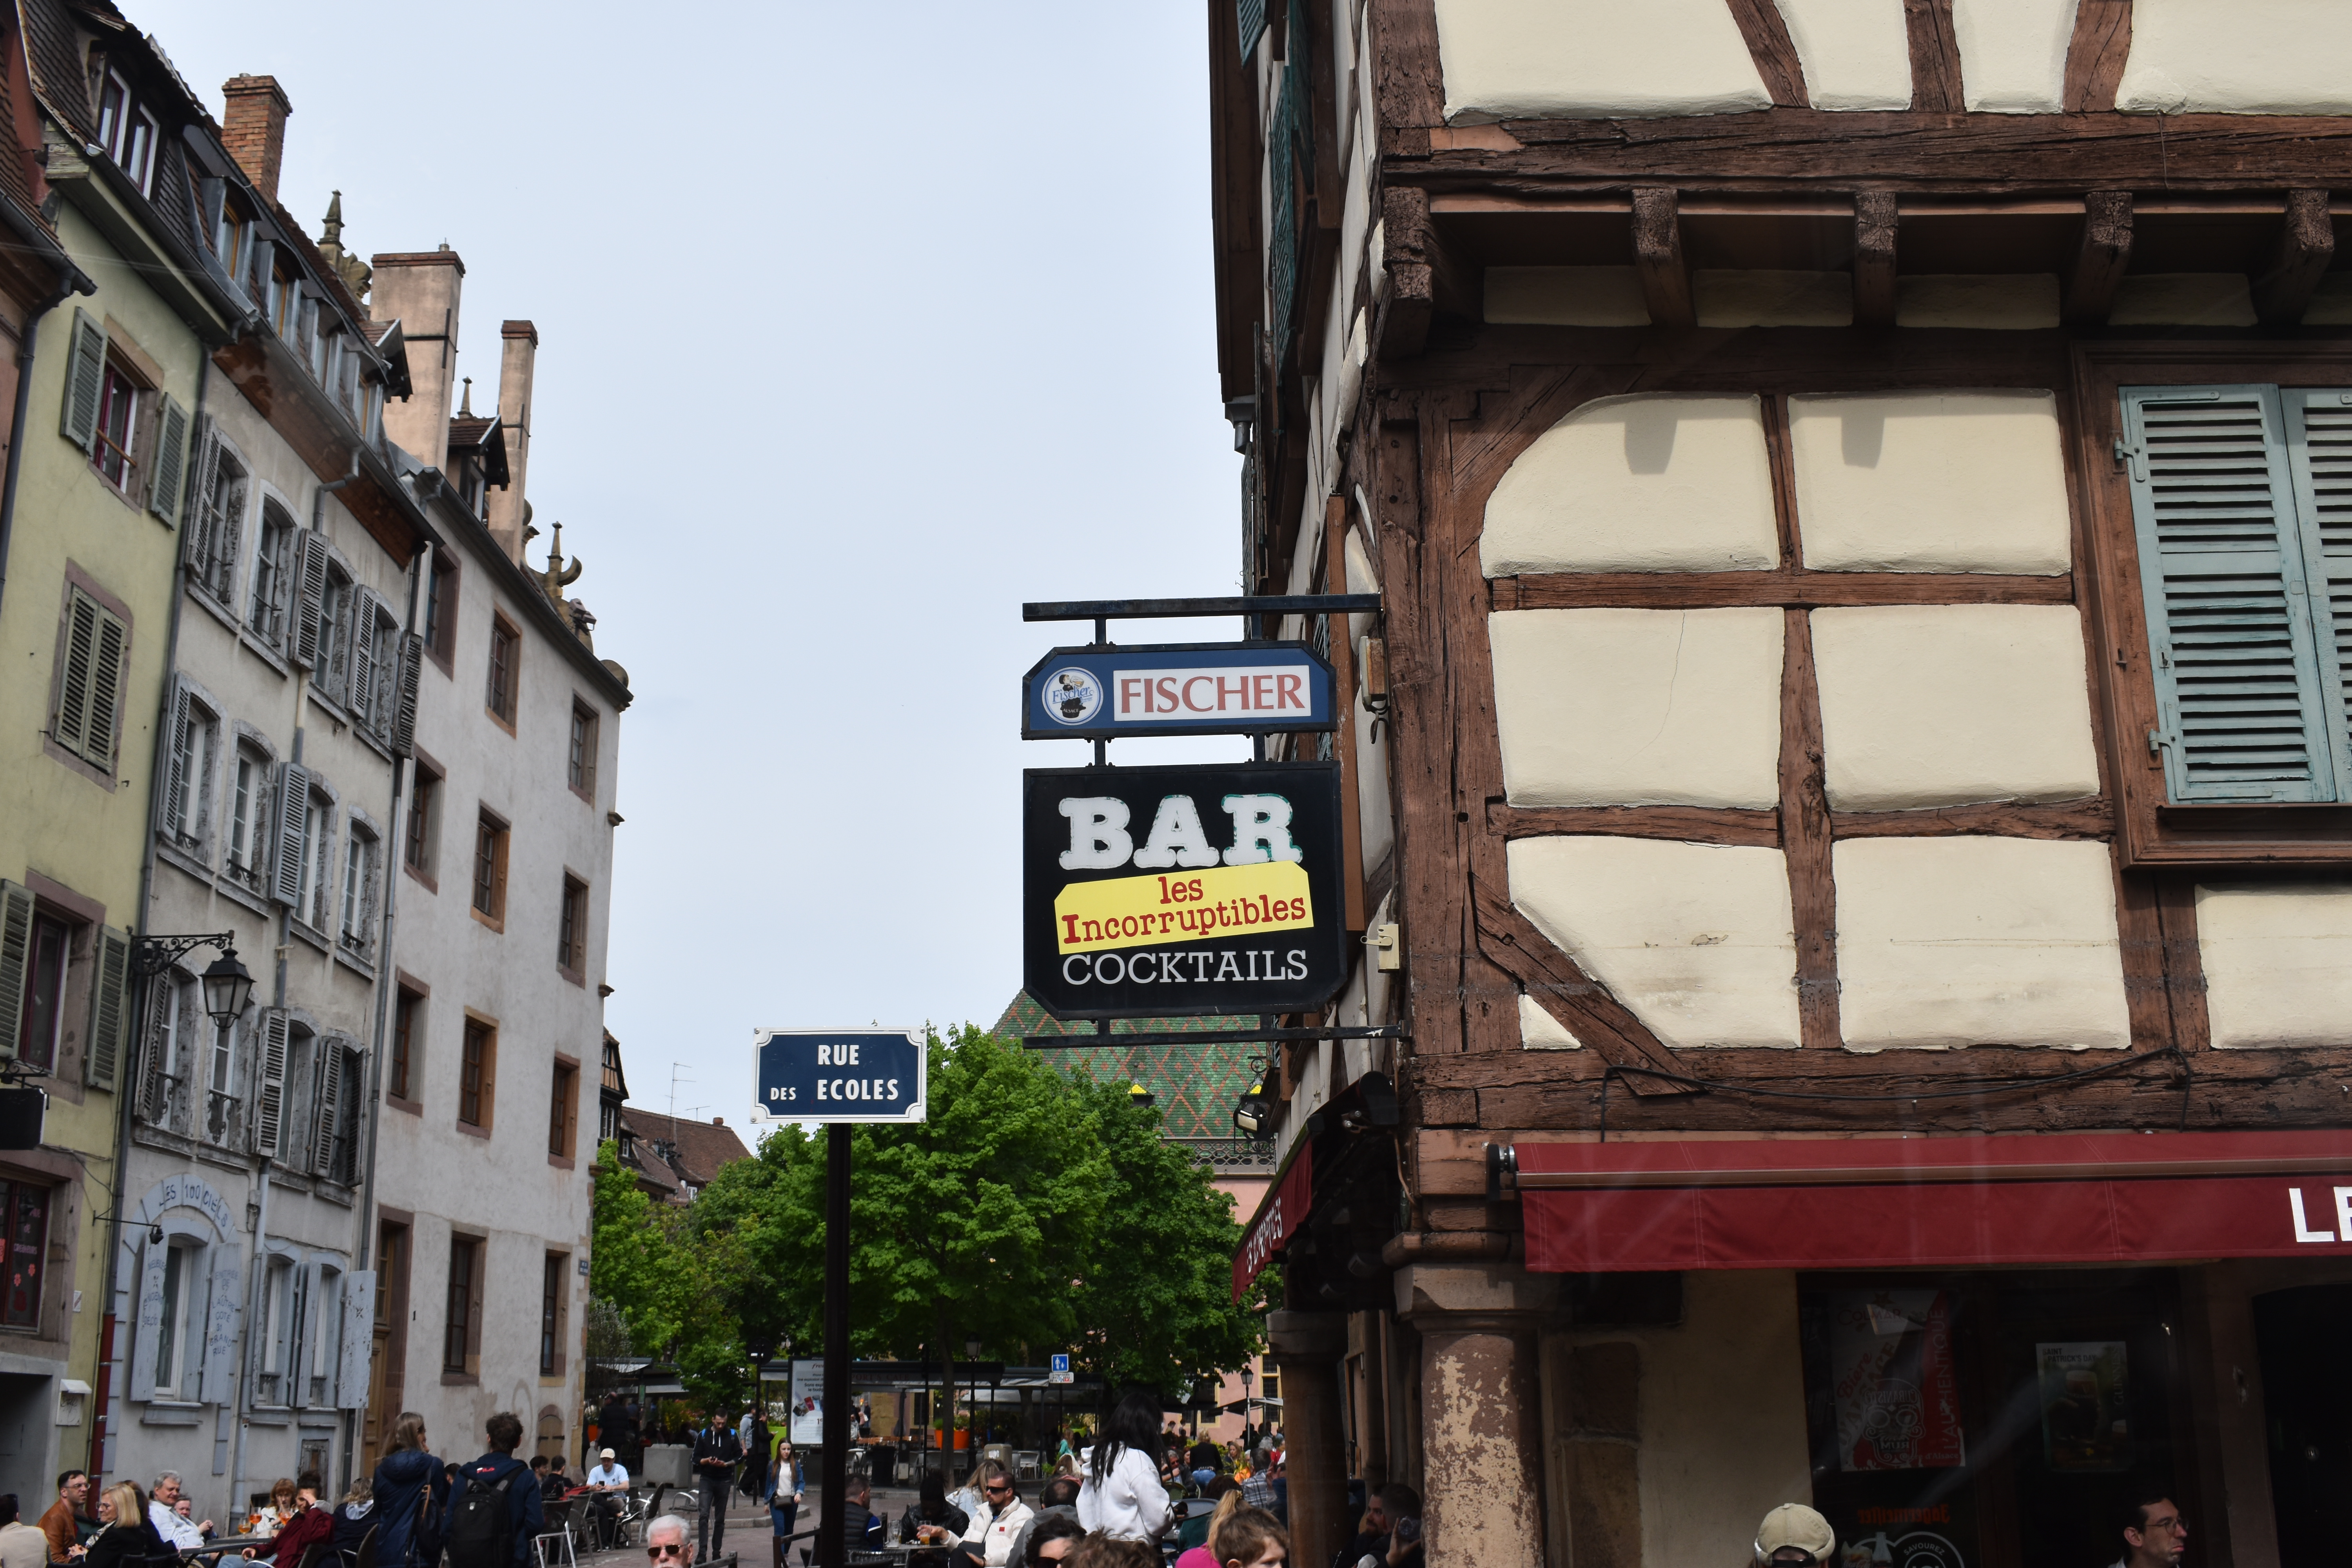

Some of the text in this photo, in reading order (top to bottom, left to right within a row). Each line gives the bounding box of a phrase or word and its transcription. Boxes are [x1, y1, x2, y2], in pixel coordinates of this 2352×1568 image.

[1053, 686, 1090, 702] Fischer
[1120, 674, 1305, 713] FISCHER
[1058, 793, 1303, 870] BAR
[1158, 877, 1203, 904] les
[1061, 894, 1306, 944] Incorruptibles
[1063, 949, 1307, 985] COCKTAILS
[818, 1045, 859, 1065] RUE
[770, 1079, 898, 1100] DES ECOLES
[159, 1185, 176, 1207] LES
[185, 1184, 200, 1200] 100
[213, 1347, 226, 1356] RUE
[1837, 1352, 1872, 1399] Bière
[1904, 1542, 1945, 1556] SAVOUREZ
